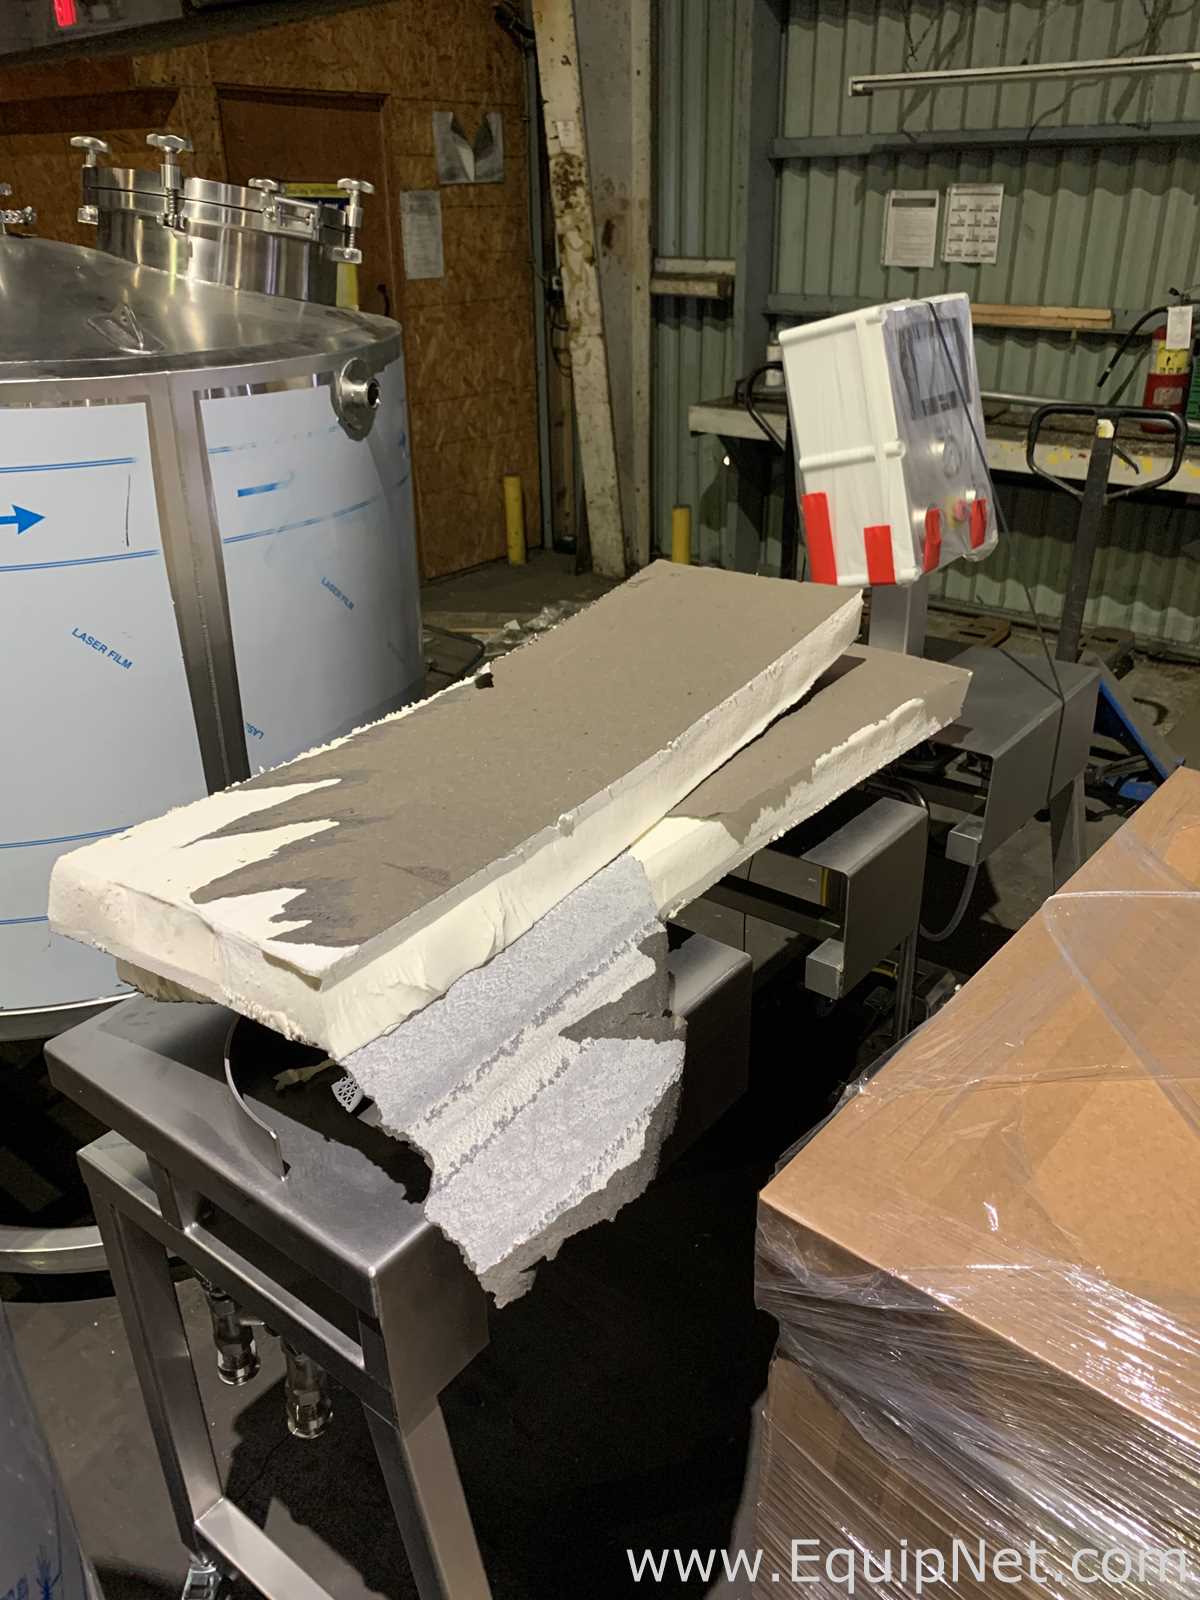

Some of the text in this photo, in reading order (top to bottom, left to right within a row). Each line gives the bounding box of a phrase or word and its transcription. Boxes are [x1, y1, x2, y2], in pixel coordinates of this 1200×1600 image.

[320, 576, 342, 600] LASER
[72, 627, 133, 669] LASER FILM
